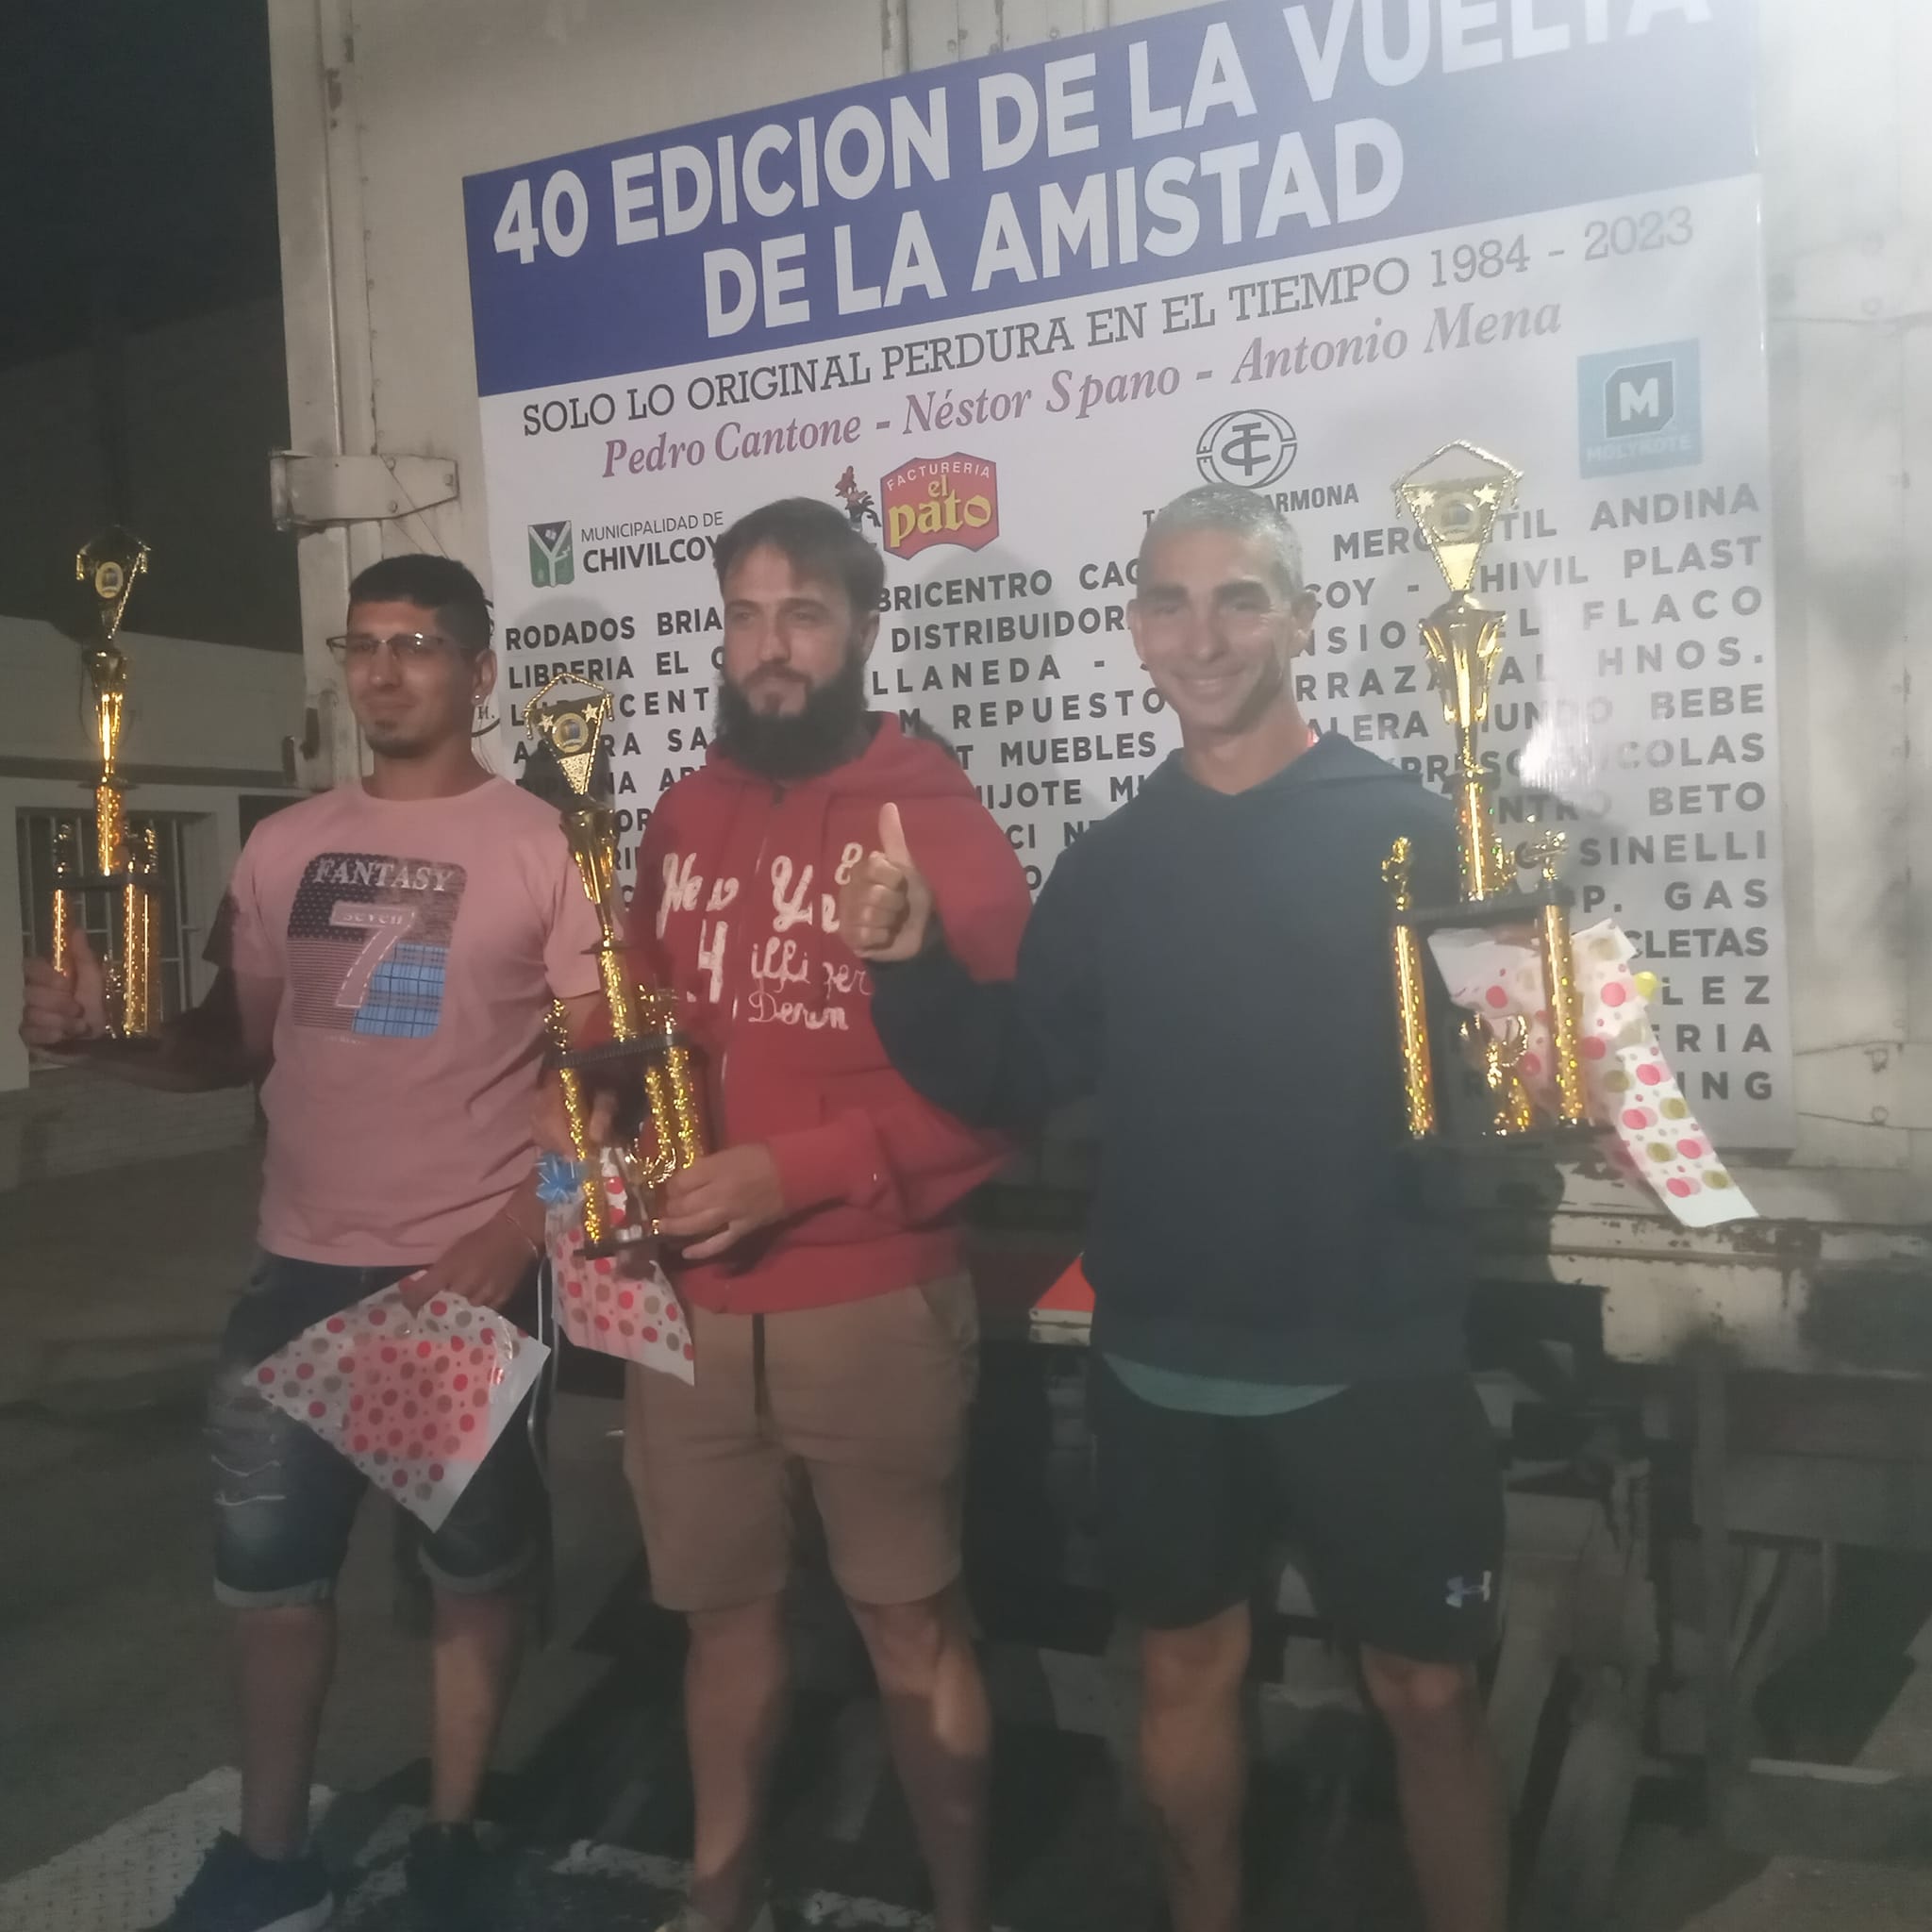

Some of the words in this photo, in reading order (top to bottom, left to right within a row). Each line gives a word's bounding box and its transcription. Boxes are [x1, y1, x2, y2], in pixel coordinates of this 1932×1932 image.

[493, 169, 590, 264] 40
[610, 87, 950, 245] EDICION
[978, 53, 1099, 172] DE
[1129, 21, 1257, 140] LA
[704, 233, 810, 338] DE
[834, 209, 947, 315] LA
[972, 117, 1405, 291] AMISTAD
[523, 392, 616, 436] SOLO
[627, 384, 675, 421] LO
[688, 352, 871, 410] ORIGINAL
[882, 316, 1074, 380] PERDURA
[1088, 302, 1147, 347] EN
[1162, 291, 1215, 336] EL
[1228, 257, 1409, 324] TIEMPO
[1429, 233, 1530, 287] 1984
[1584, 205, 1694, 262] 2023
[602, 432, 705, 478] Pedro
[715, 414, 861, 462] Cantone
[902, 388, 1031, 435] Néstor
[1045, 369, 1179, 418] Spano
[1230, 319, 1407, 383] Antonio
[1423, 301, 1562, 354] Mena
[1620, 377, 1659, 421] M
[886, 461, 991, 491] FACTURERIA
[928, 475, 948, 498] el
[1265, 483, 1358, 512] ARMONA
[581, 515, 699, 542] MUNICIPALIDAD
[703, 511, 724, 528] DE
[888, 490, 992, 548] pato
[506, 616, 635, 651] RODADOS
[879, 569, 1052, 611] BRICENTRO
[1590, 482, 1758, 531] ANDINA
[508, 656, 634, 690] LIBRERIA
[657, 651, 689, 675] EL
[891, 605, 1130, 653] DISTRIBUIDOR
[1480, 555, 1589, 593] HIVIL
[1624, 535, 1761, 578] PLAST
[873, 654, 1060, 695] LLANEDA
[1583, 585, 1761, 630] FLACO
[953, 687, 1165, 729] REPUESTO
[1598, 636, 1763, 677] HNOS.
[1001, 731, 1157, 768] MUEBLES
[1652, 684, 1763, 720] BEBE
[1649, 781, 1765, 816] BETO
[312, 858, 455, 891] FANTASY
[1664, 878, 1768, 910] GAS
